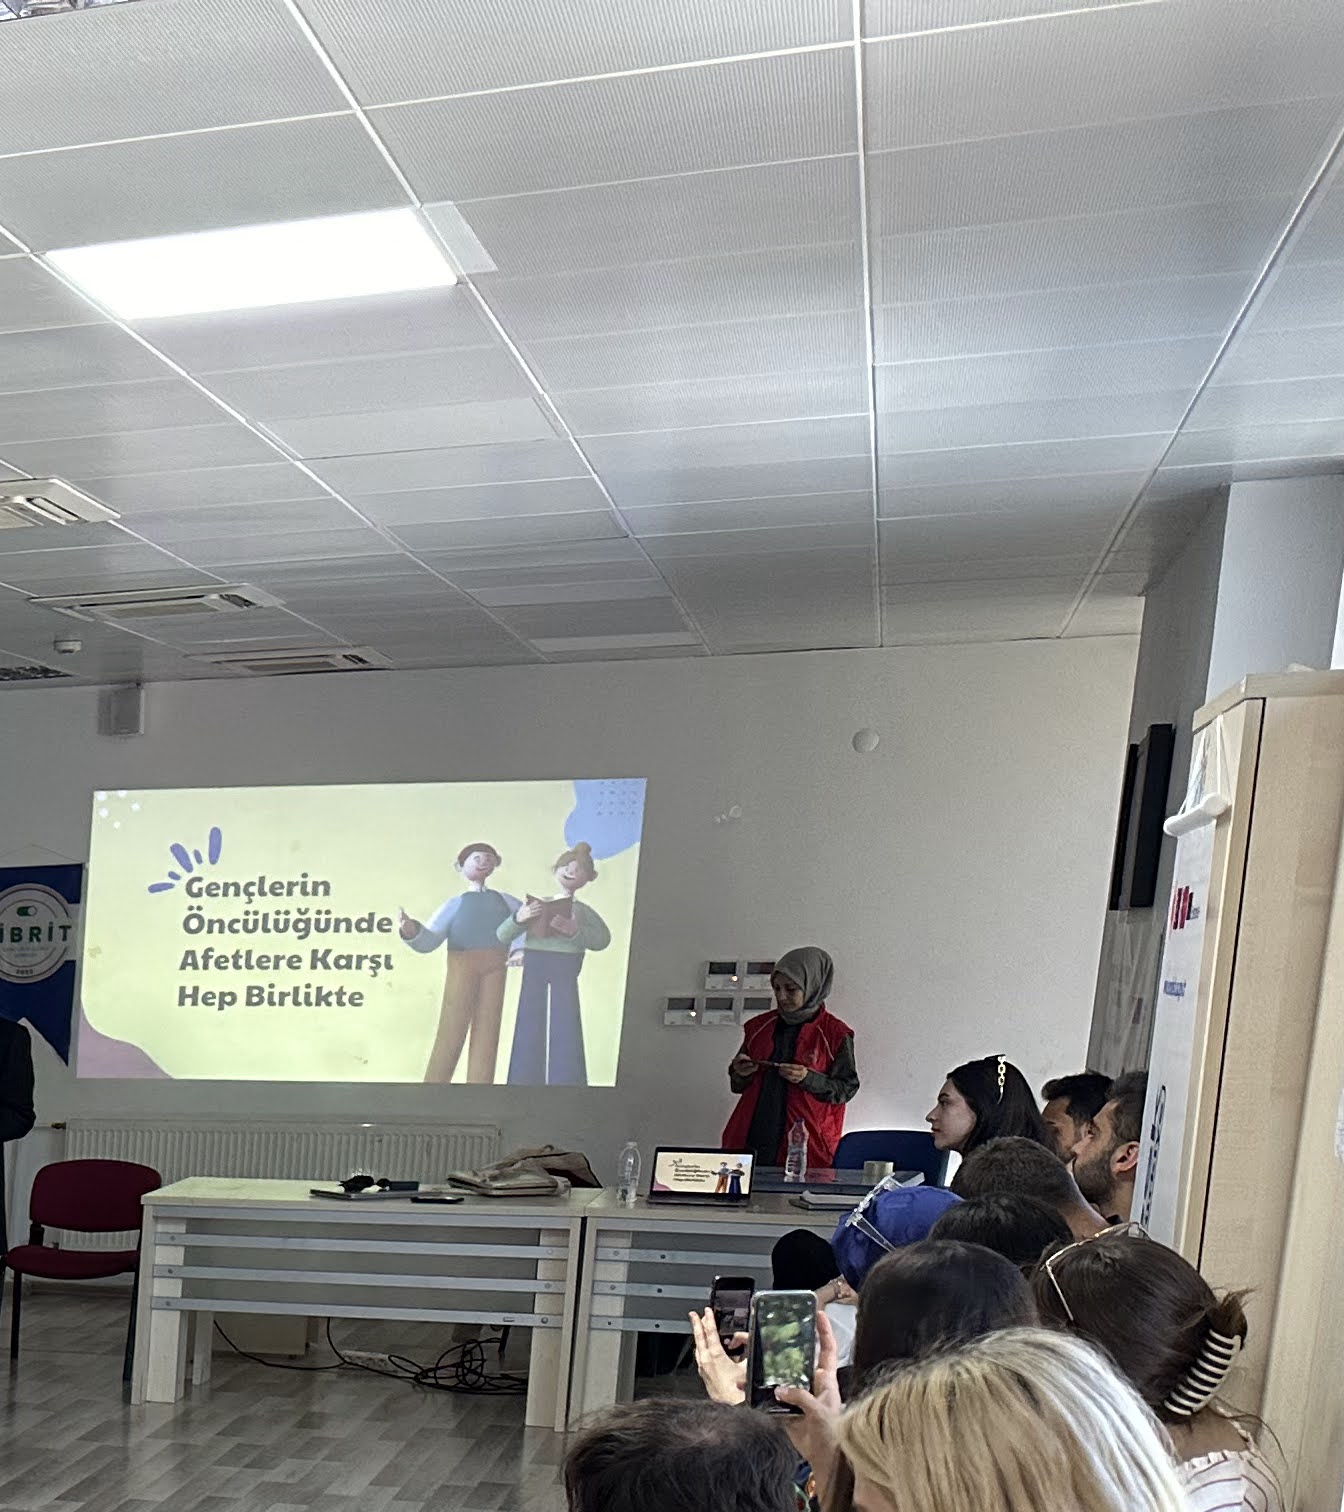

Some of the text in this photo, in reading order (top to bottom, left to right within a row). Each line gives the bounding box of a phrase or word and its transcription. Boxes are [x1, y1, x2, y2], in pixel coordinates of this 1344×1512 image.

[185, 872, 331, 904] Gençlerin
[183, 905, 393, 940] Öncülüğünde
[179, 947, 394, 977] Afetlere Karşı
[178, 983, 365, 1011] Hep Birlikte
